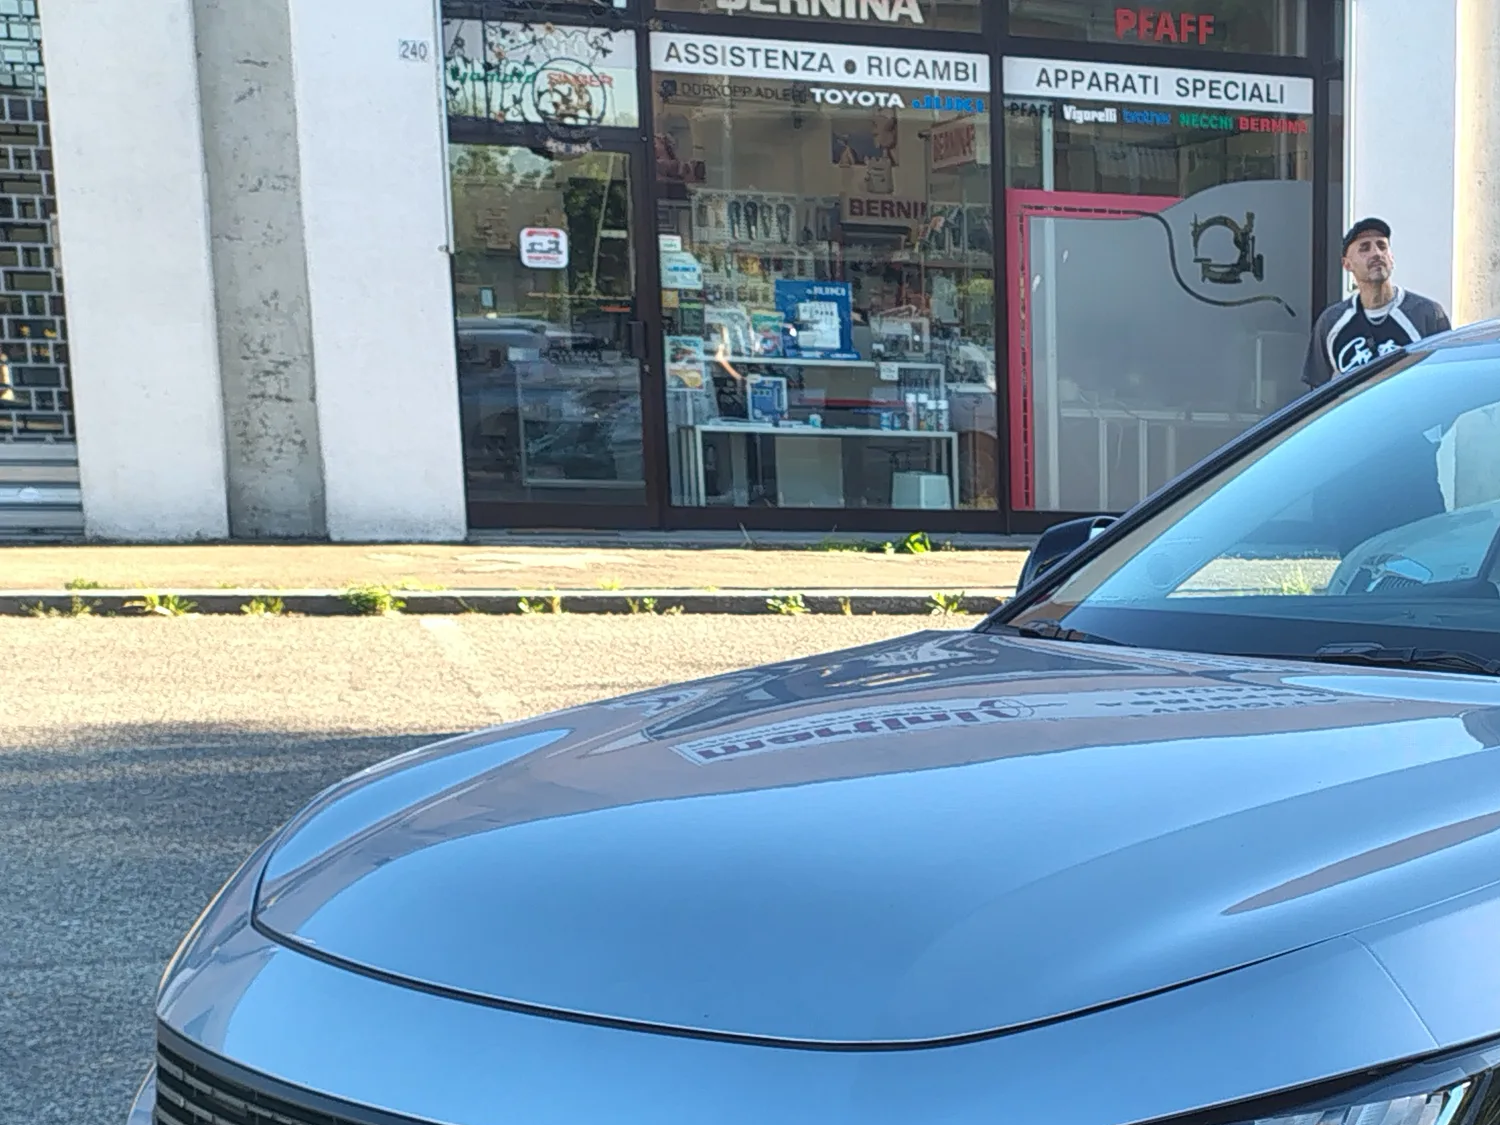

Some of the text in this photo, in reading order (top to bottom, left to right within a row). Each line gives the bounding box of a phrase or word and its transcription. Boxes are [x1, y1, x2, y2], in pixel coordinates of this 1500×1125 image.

[1115, 8, 1215, 45] PFAFF
[400, 40, 428, 61] 240
[664, 41, 977, 83] ASSISTENZA RICAMBI
[1036, 67, 1284, 104] APPARATI SPECIALI
[810, 88, 905, 108] TOYOTA
[911, 95, 984, 113] JUKI
[1178, 112, 1233, 130] NECCHI
[1238, 116, 1308, 134] BERNINA
